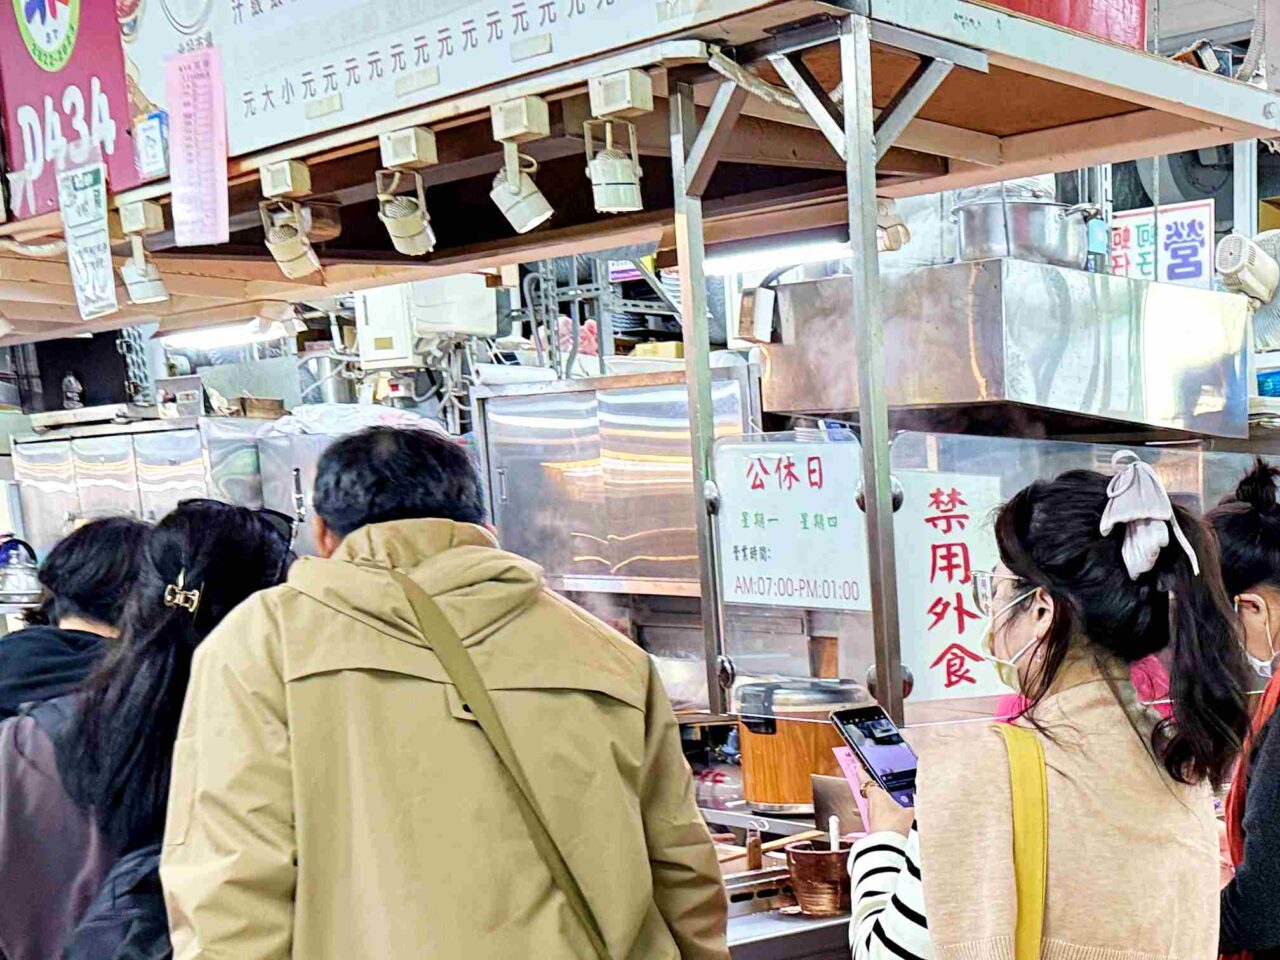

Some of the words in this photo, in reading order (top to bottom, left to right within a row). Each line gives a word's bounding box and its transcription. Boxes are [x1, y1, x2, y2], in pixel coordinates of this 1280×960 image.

[17, 76, 116, 180] D434
[746, 456, 824, 491] 公休日
[741, 512, 780, 530] 星期一
[800, 512, 838, 530] 星期四
[734, 576, 860, 601] AM:07:00-PM:01:00
[924, 487, 986, 689] 禁用外食
